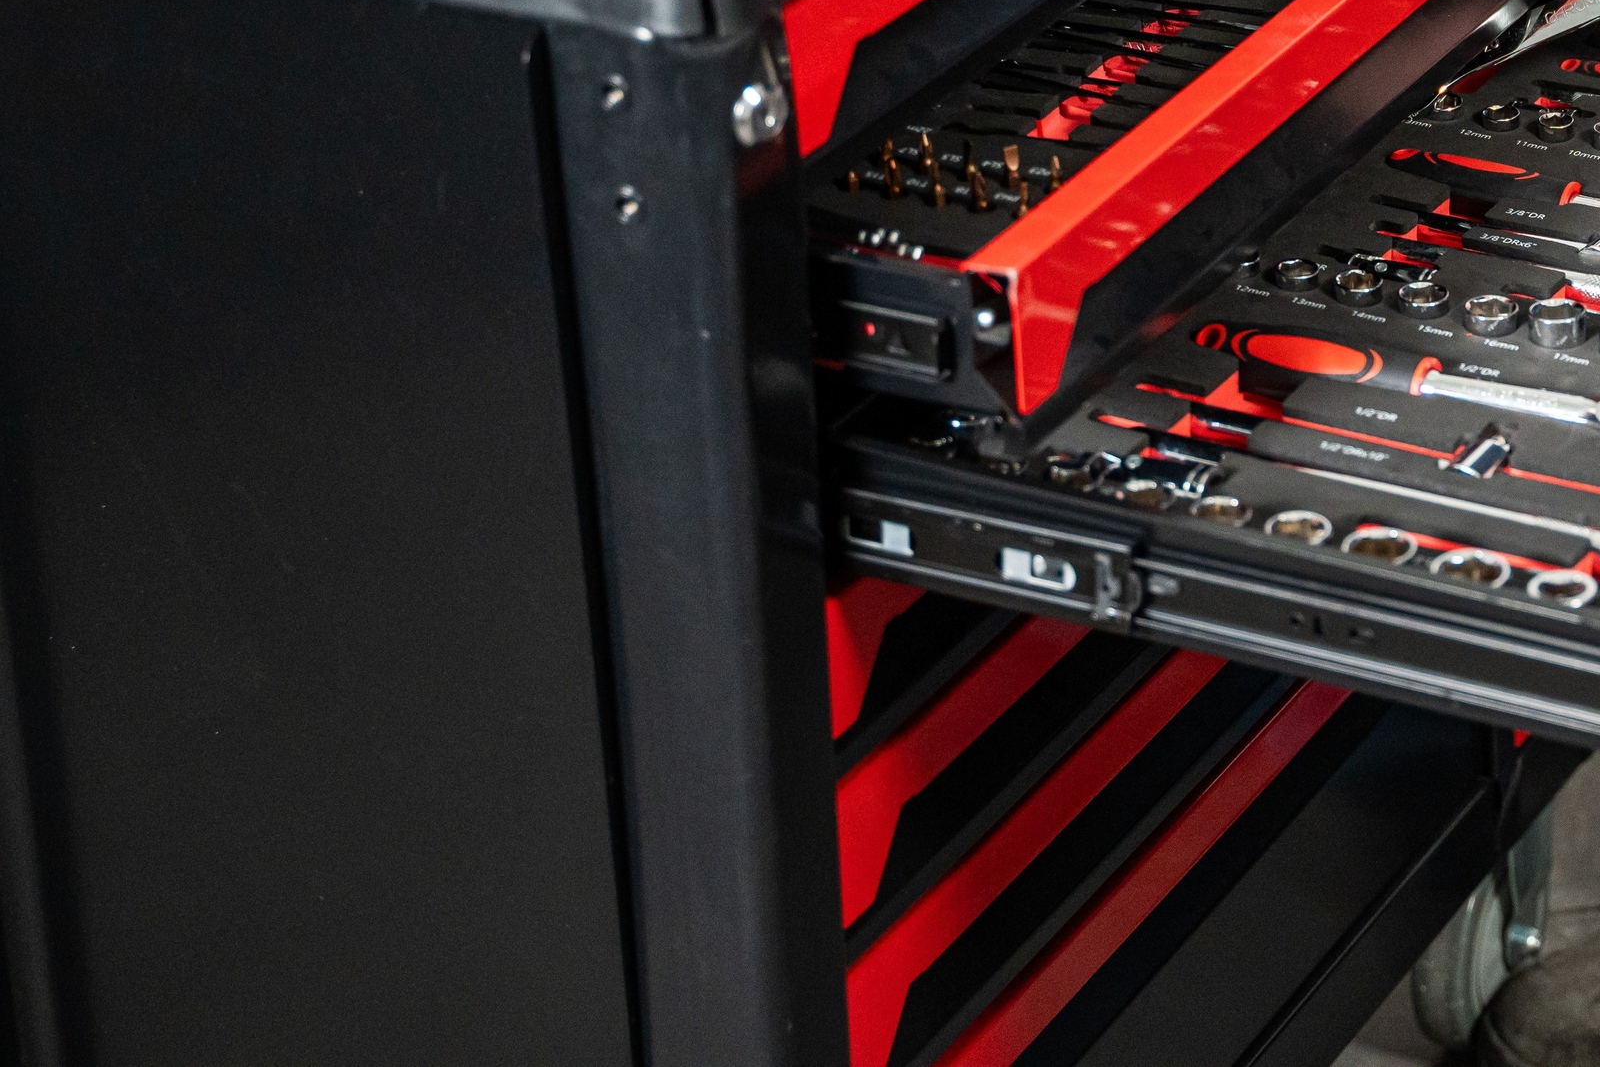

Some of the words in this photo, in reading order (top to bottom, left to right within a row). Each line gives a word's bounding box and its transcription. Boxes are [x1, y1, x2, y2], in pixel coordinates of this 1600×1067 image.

[1460, 129, 1492, 140] 12mm
[1516, 139, 1548, 151] 11mm
[1568, 149, 1600, 160] 10mm
[1504, 208, 1546, 220] 3/8"DR
[1479, 233, 1538, 249] 3/8"DRx6"
[1236, 284, 1270, 297] 12mm
[1292, 297, 1326, 309] 13mm
[1352, 310, 1387, 323] 14mm
[1418, 325, 1454, 337] 15mm
